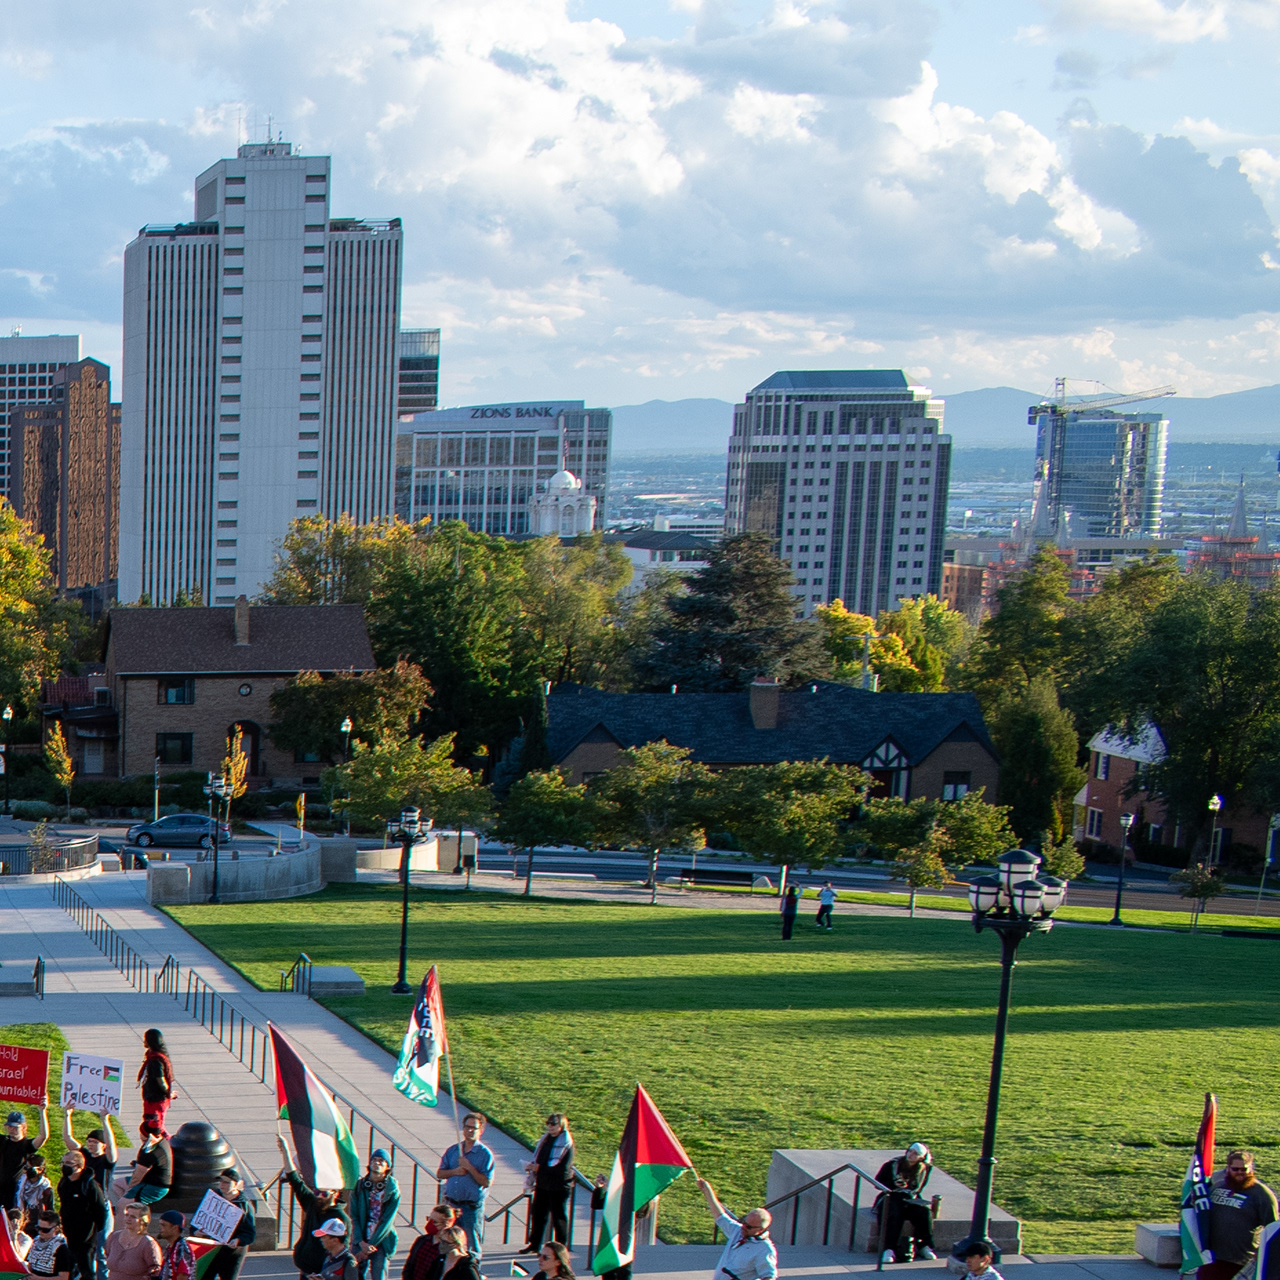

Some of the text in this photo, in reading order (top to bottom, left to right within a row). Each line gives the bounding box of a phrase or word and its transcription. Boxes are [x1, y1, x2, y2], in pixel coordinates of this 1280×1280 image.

[470, 406, 554, 419] ZIONS BANK
[66, 1055, 102, 1076] Free
[64, 1081, 120, 1111] Palestine
